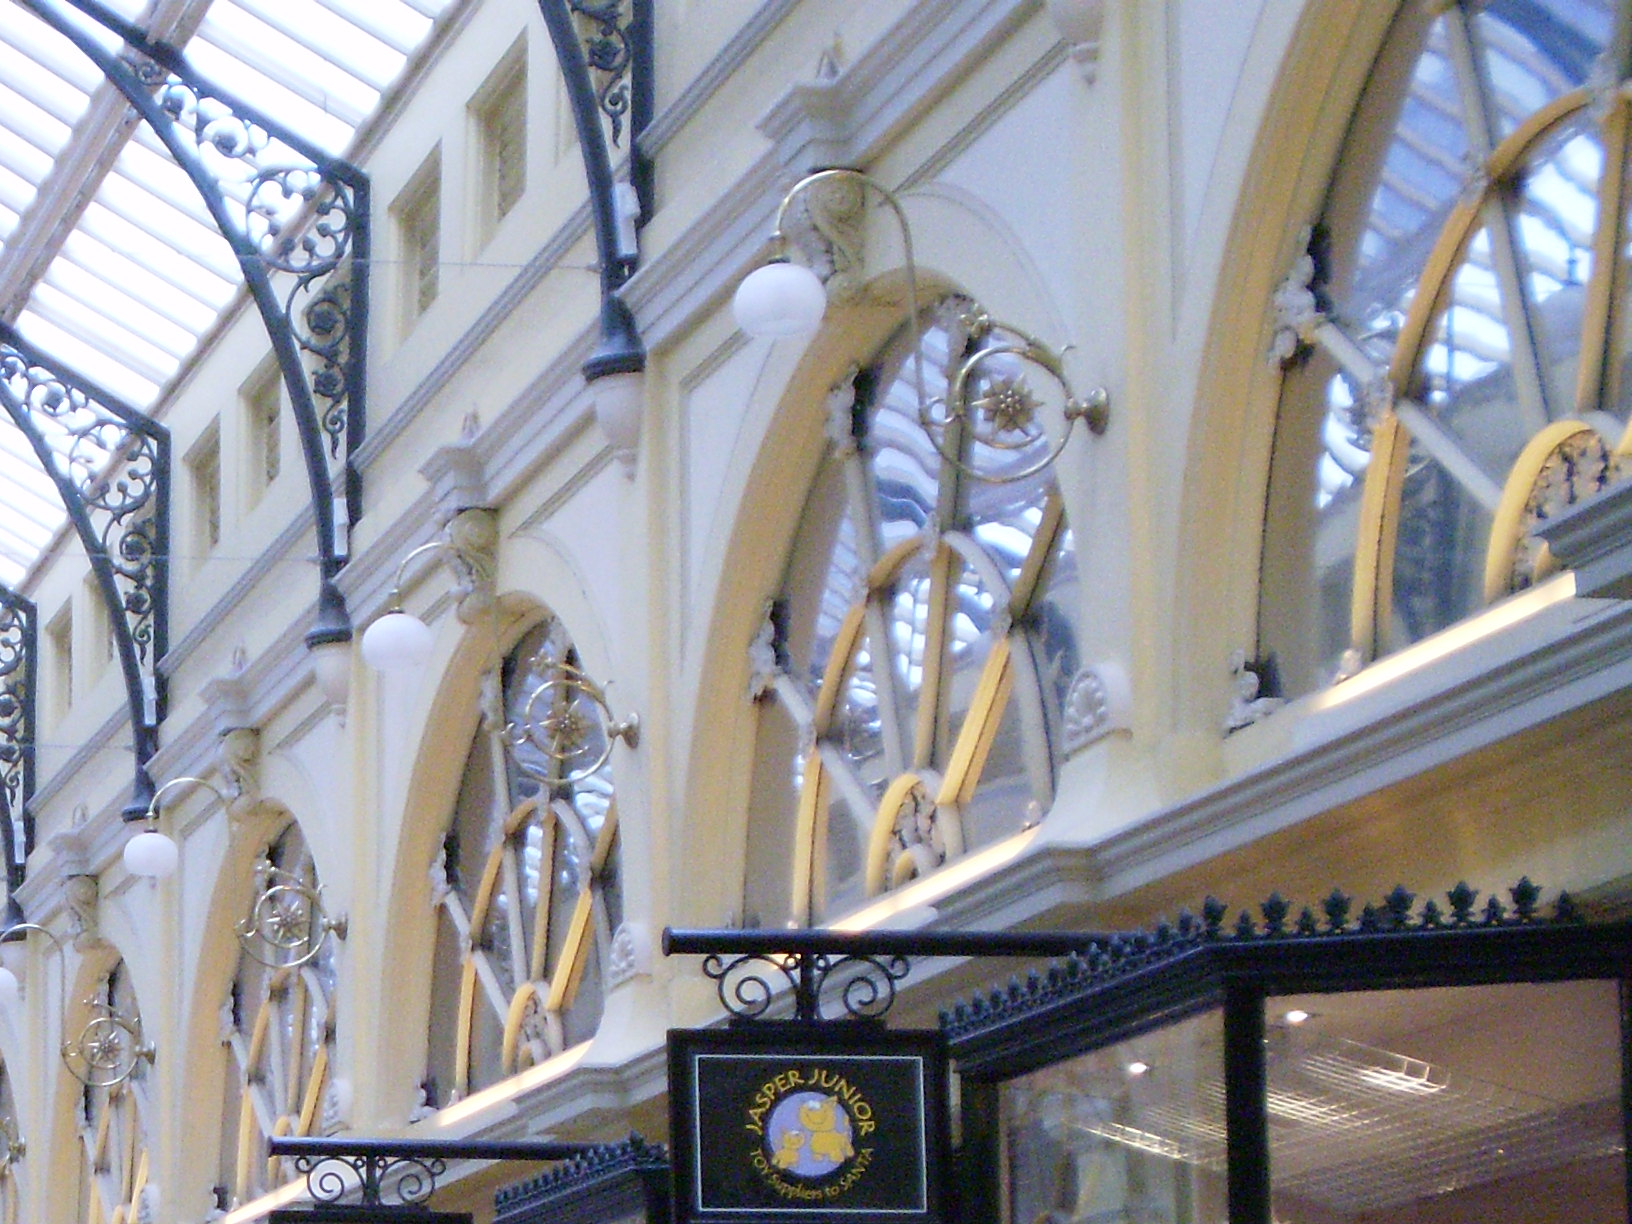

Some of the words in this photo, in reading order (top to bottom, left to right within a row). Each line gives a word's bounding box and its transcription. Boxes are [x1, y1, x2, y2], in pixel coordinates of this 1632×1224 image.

[745, 1070, 805, 1136] JASPER
[807, 1068, 876, 1136] JUNIOR
[750, 1147, 772, 1175] TOY
[824, 1186, 839, 1197] to
[840, 1148, 874, 1190] SANTA
